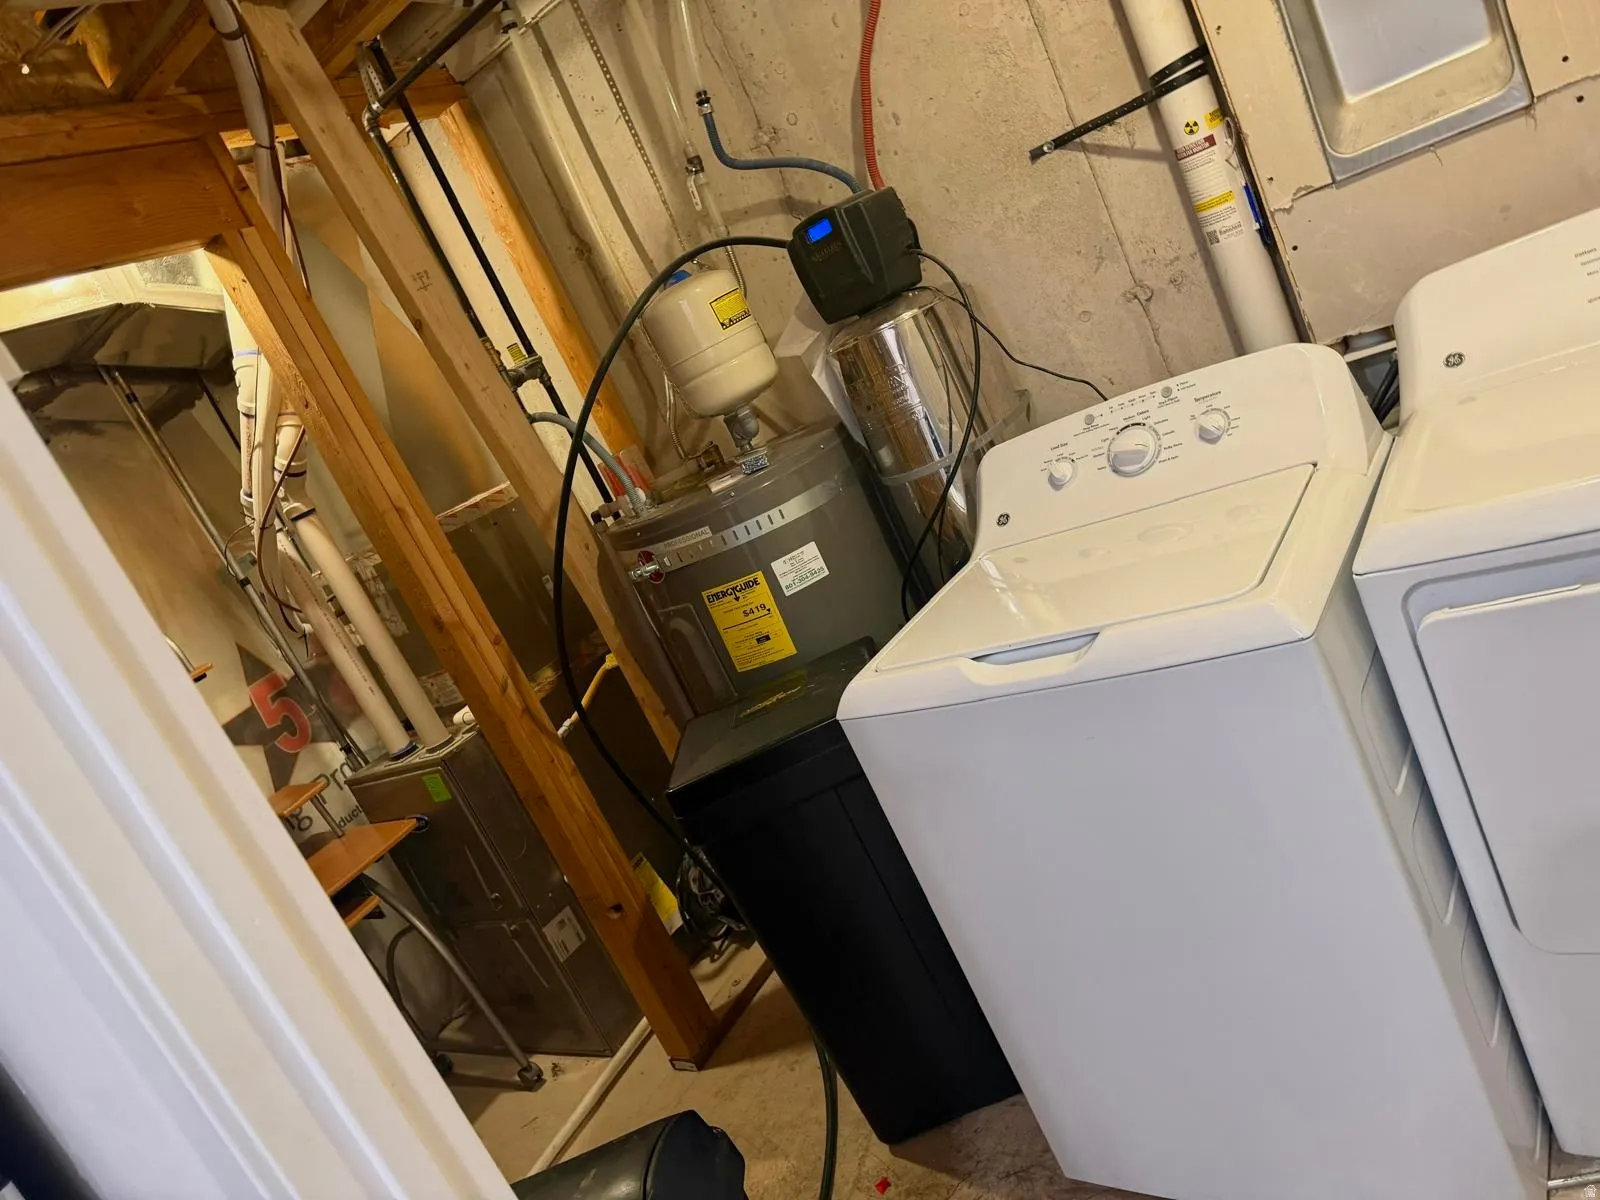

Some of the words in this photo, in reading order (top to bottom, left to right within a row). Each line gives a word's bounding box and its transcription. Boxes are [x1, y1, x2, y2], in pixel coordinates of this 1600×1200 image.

[706, 577, 761, 604] ENERGYGUIDE
[742, 603, 767, 618] $419
[249, 671, 312, 754] 5
